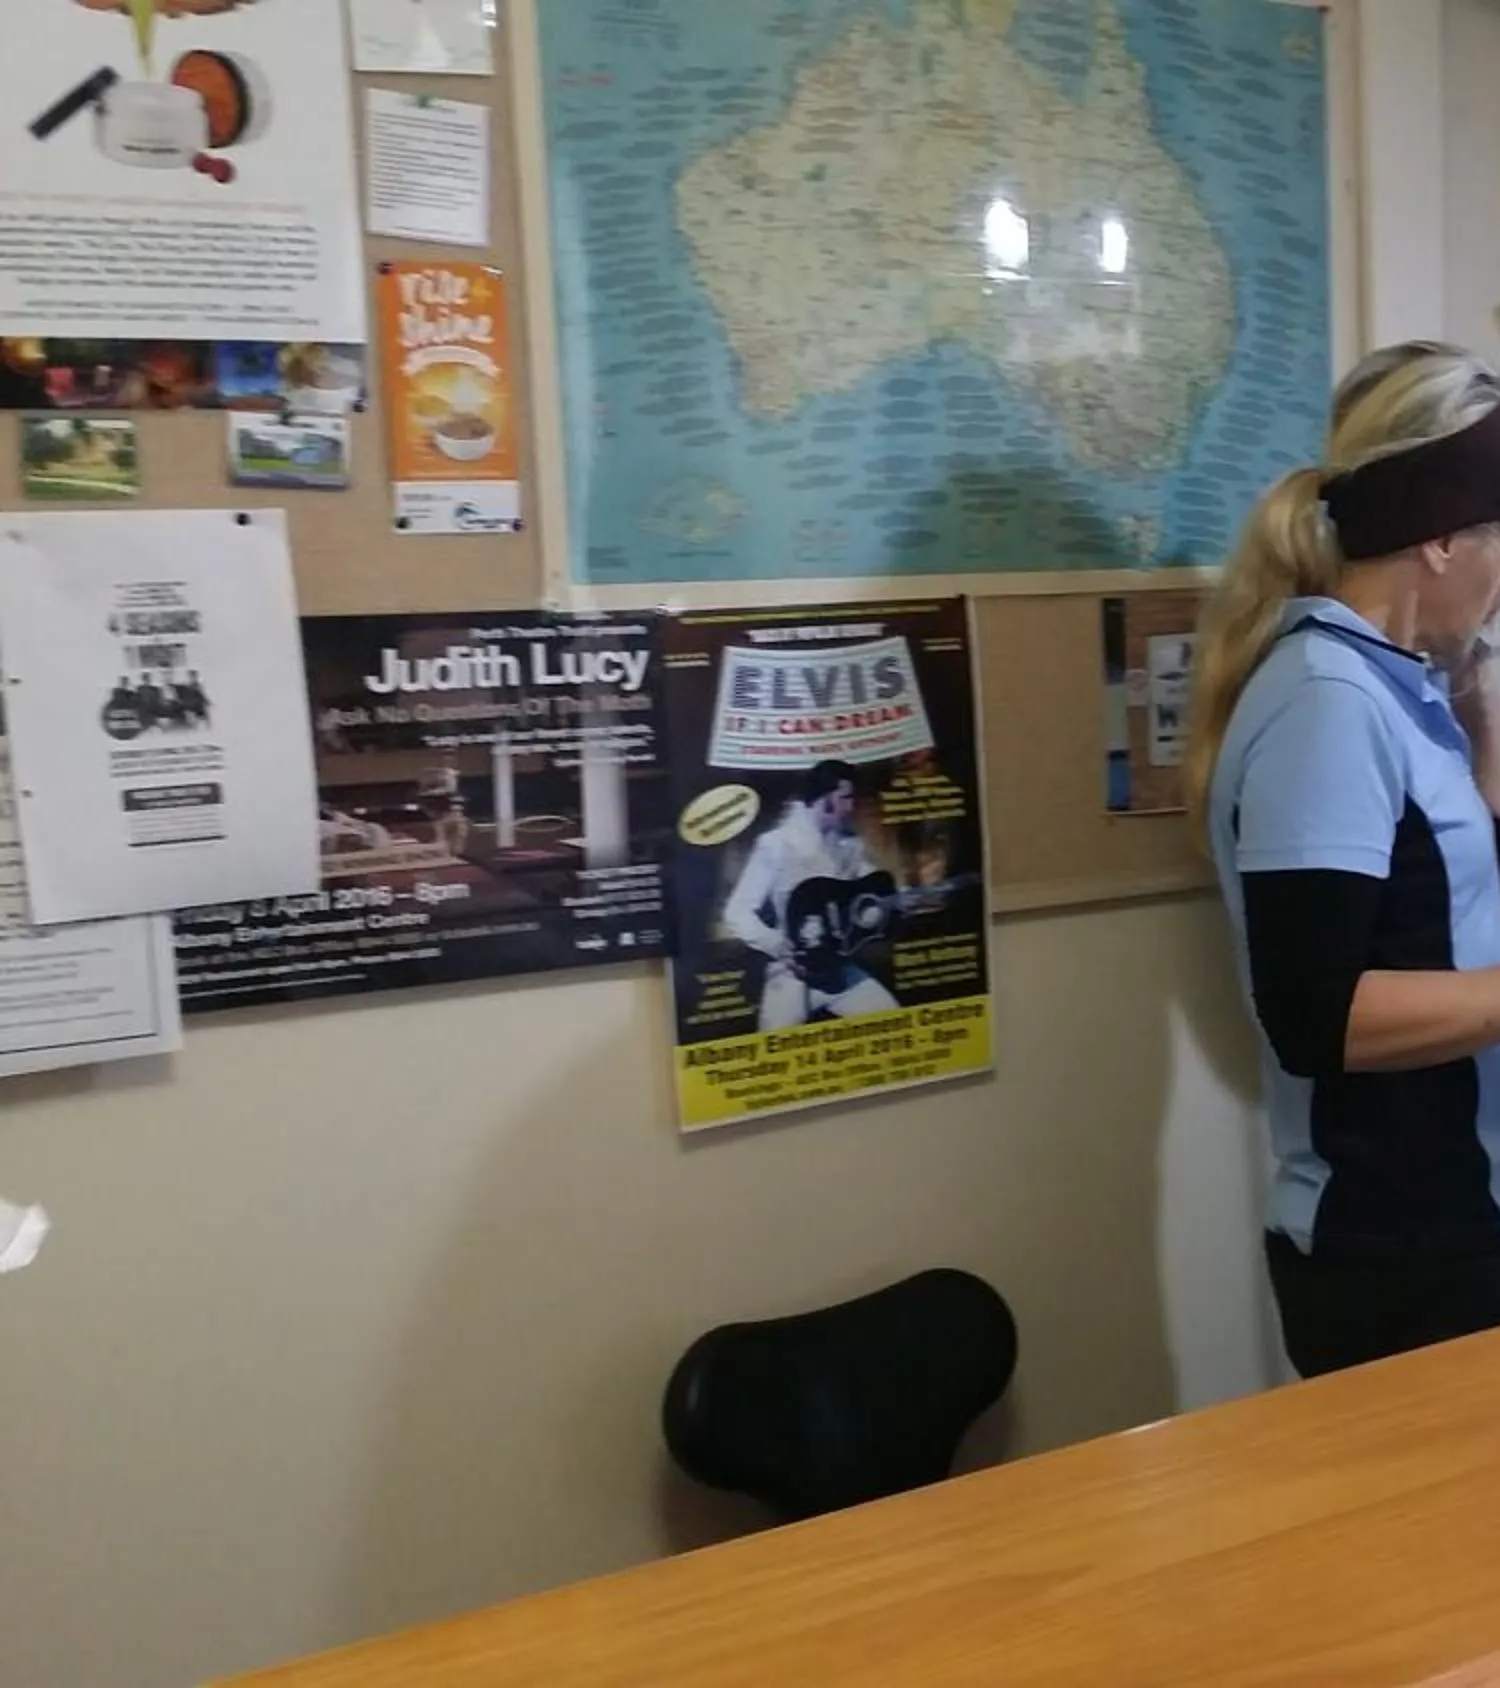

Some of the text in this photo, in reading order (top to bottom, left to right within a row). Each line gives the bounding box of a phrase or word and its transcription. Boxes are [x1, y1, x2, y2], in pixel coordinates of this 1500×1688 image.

[363, 643, 649, 693] Judith Lucy
[731, 656, 907, 710] ELVIS
[367, 912, 431, 929] Centre
[686, 1003, 985, 1067] Albany Entertainment Centre
[704, 1060, 791, 1086] Thursday
